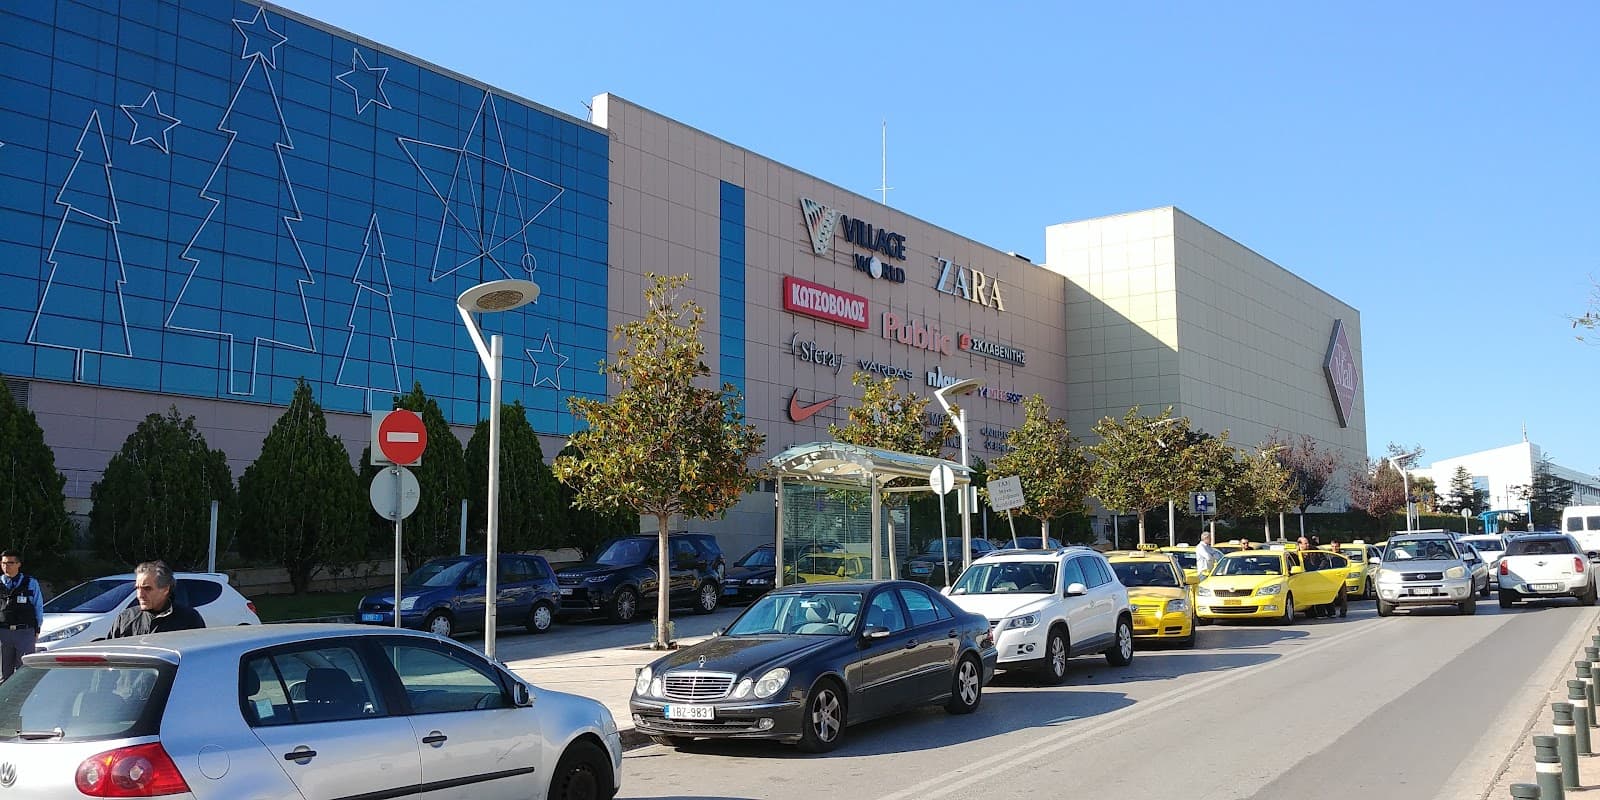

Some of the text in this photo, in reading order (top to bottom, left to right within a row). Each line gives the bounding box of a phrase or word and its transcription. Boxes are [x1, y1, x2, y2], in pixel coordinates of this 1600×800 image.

[842, 215, 906, 261] VILLAGE
[792, 283, 866, 323] ΚΩΤΣΟΒΟΛΟΣ
[935, 257, 1005, 311] ZARA
[882, 312, 953, 356] Public
[971, 338, 1026, 364] ΣΚΛΑΒΕΝΙΤΗΣ
[859, 359, 913, 381] VARDAS
